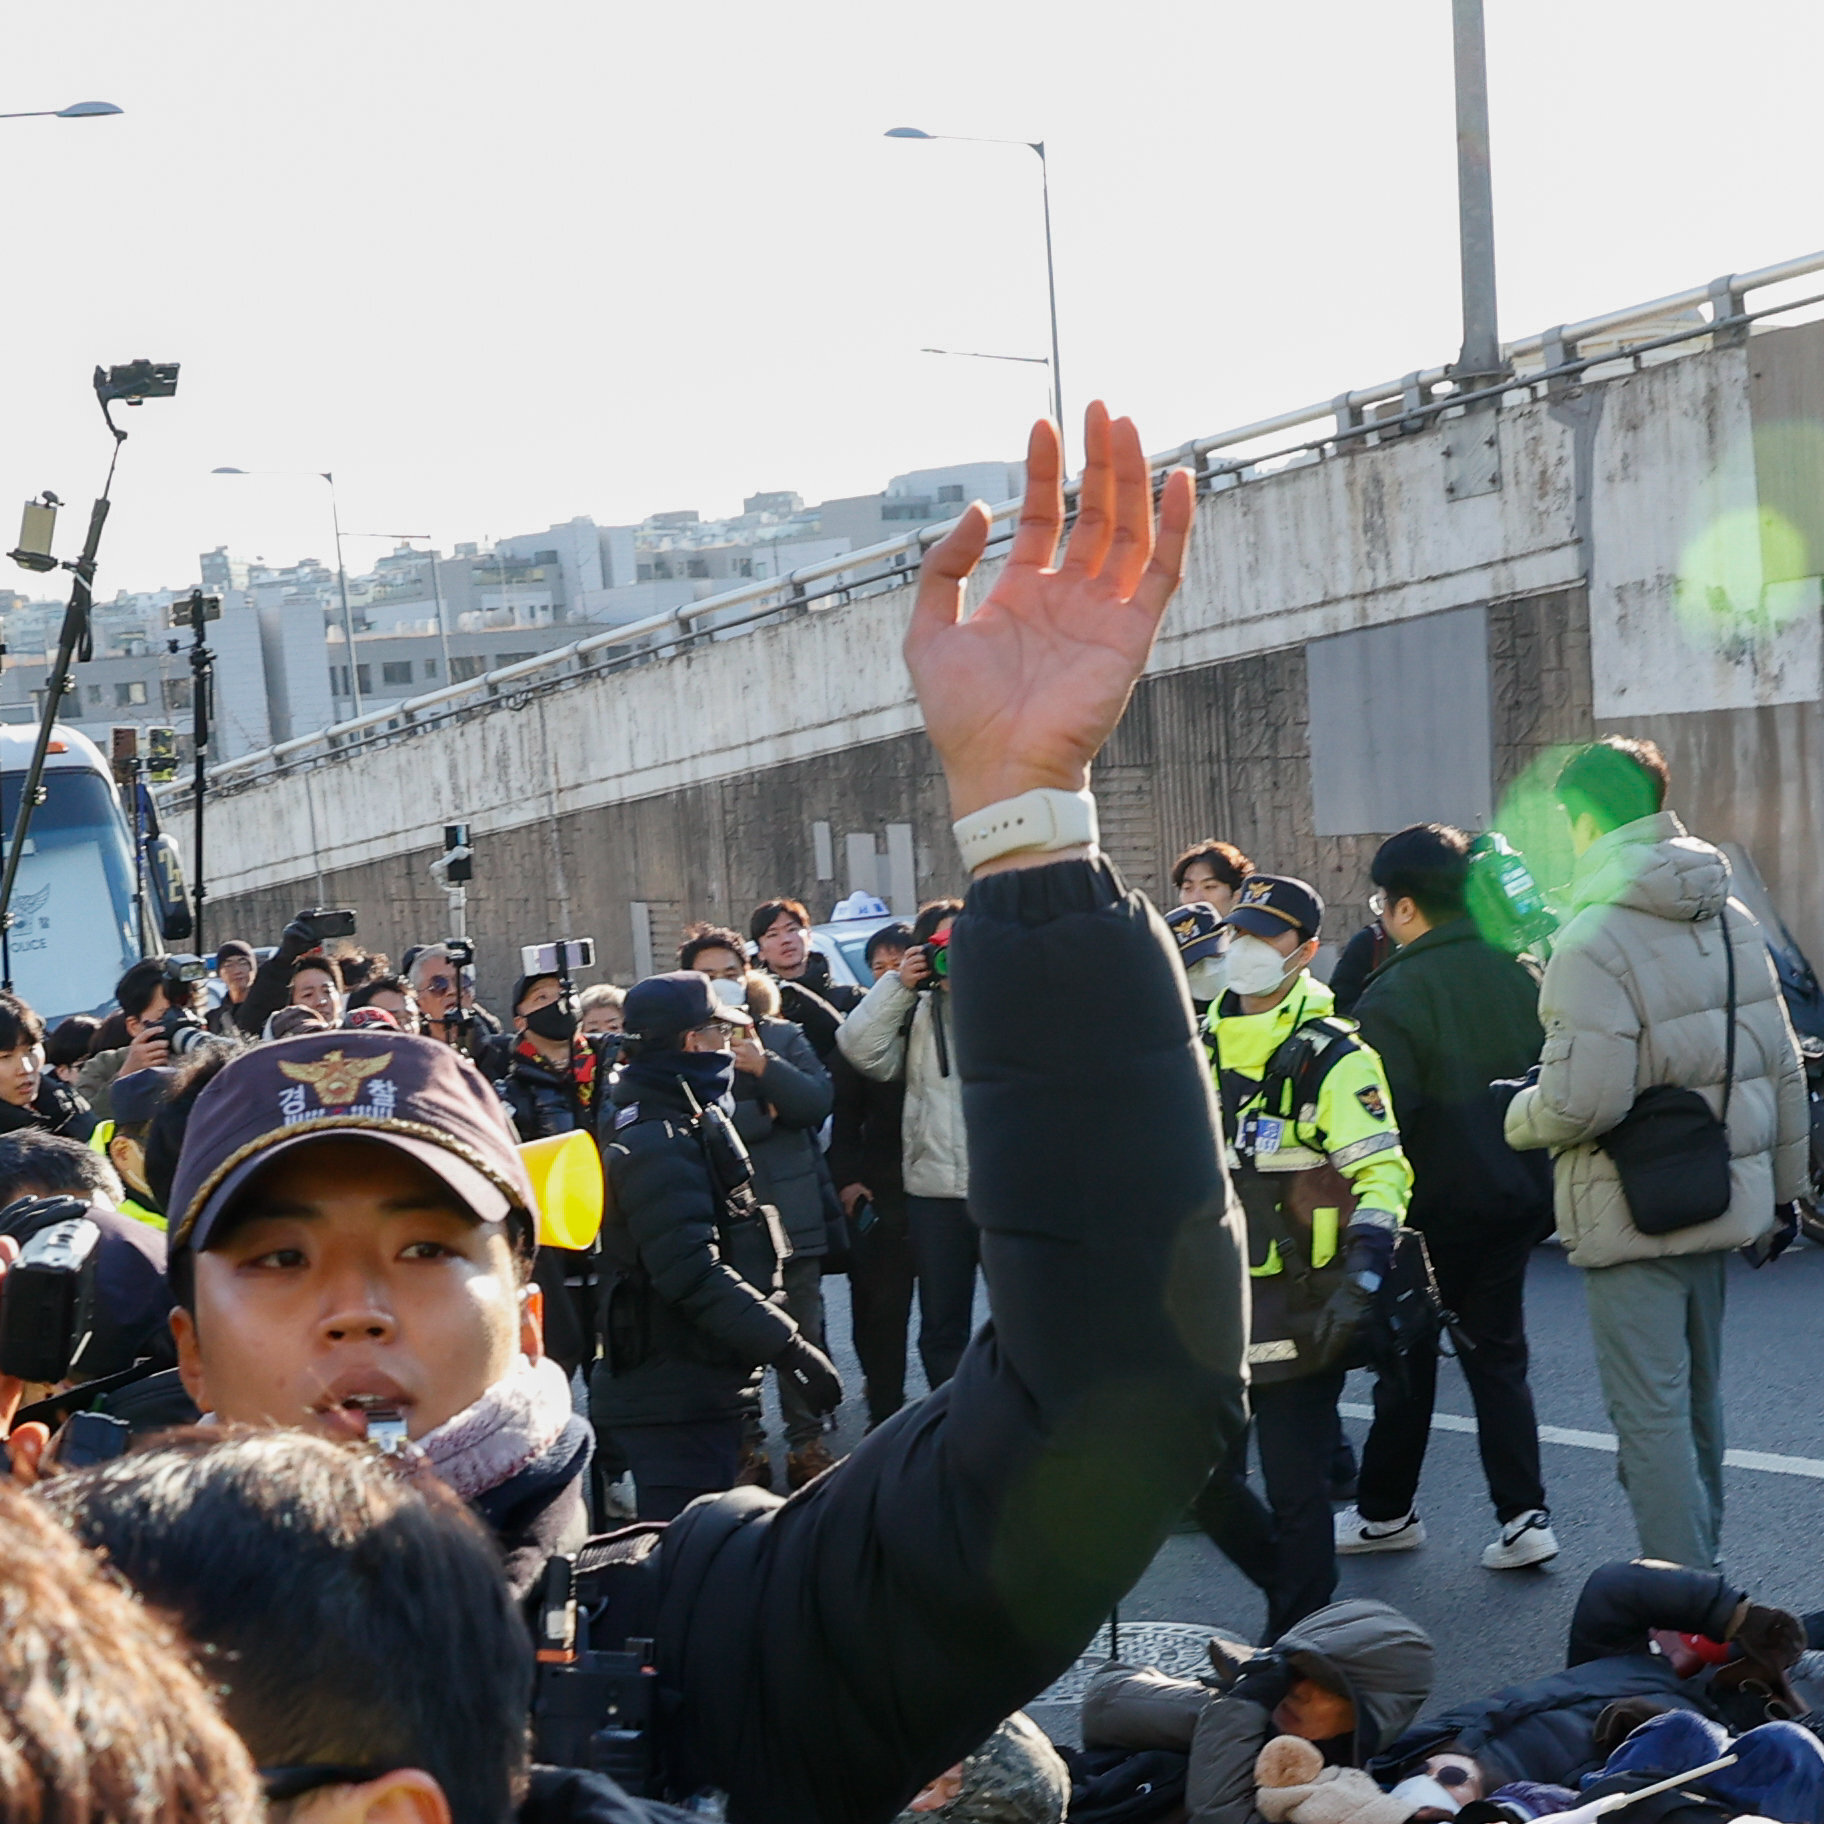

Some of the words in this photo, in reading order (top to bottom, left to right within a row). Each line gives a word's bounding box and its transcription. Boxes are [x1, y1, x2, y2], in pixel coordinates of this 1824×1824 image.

[9, 938, 48, 953] OLICE
[278, 1083, 307, 1116] 경
[367, 1078, 398, 1108] 찰
